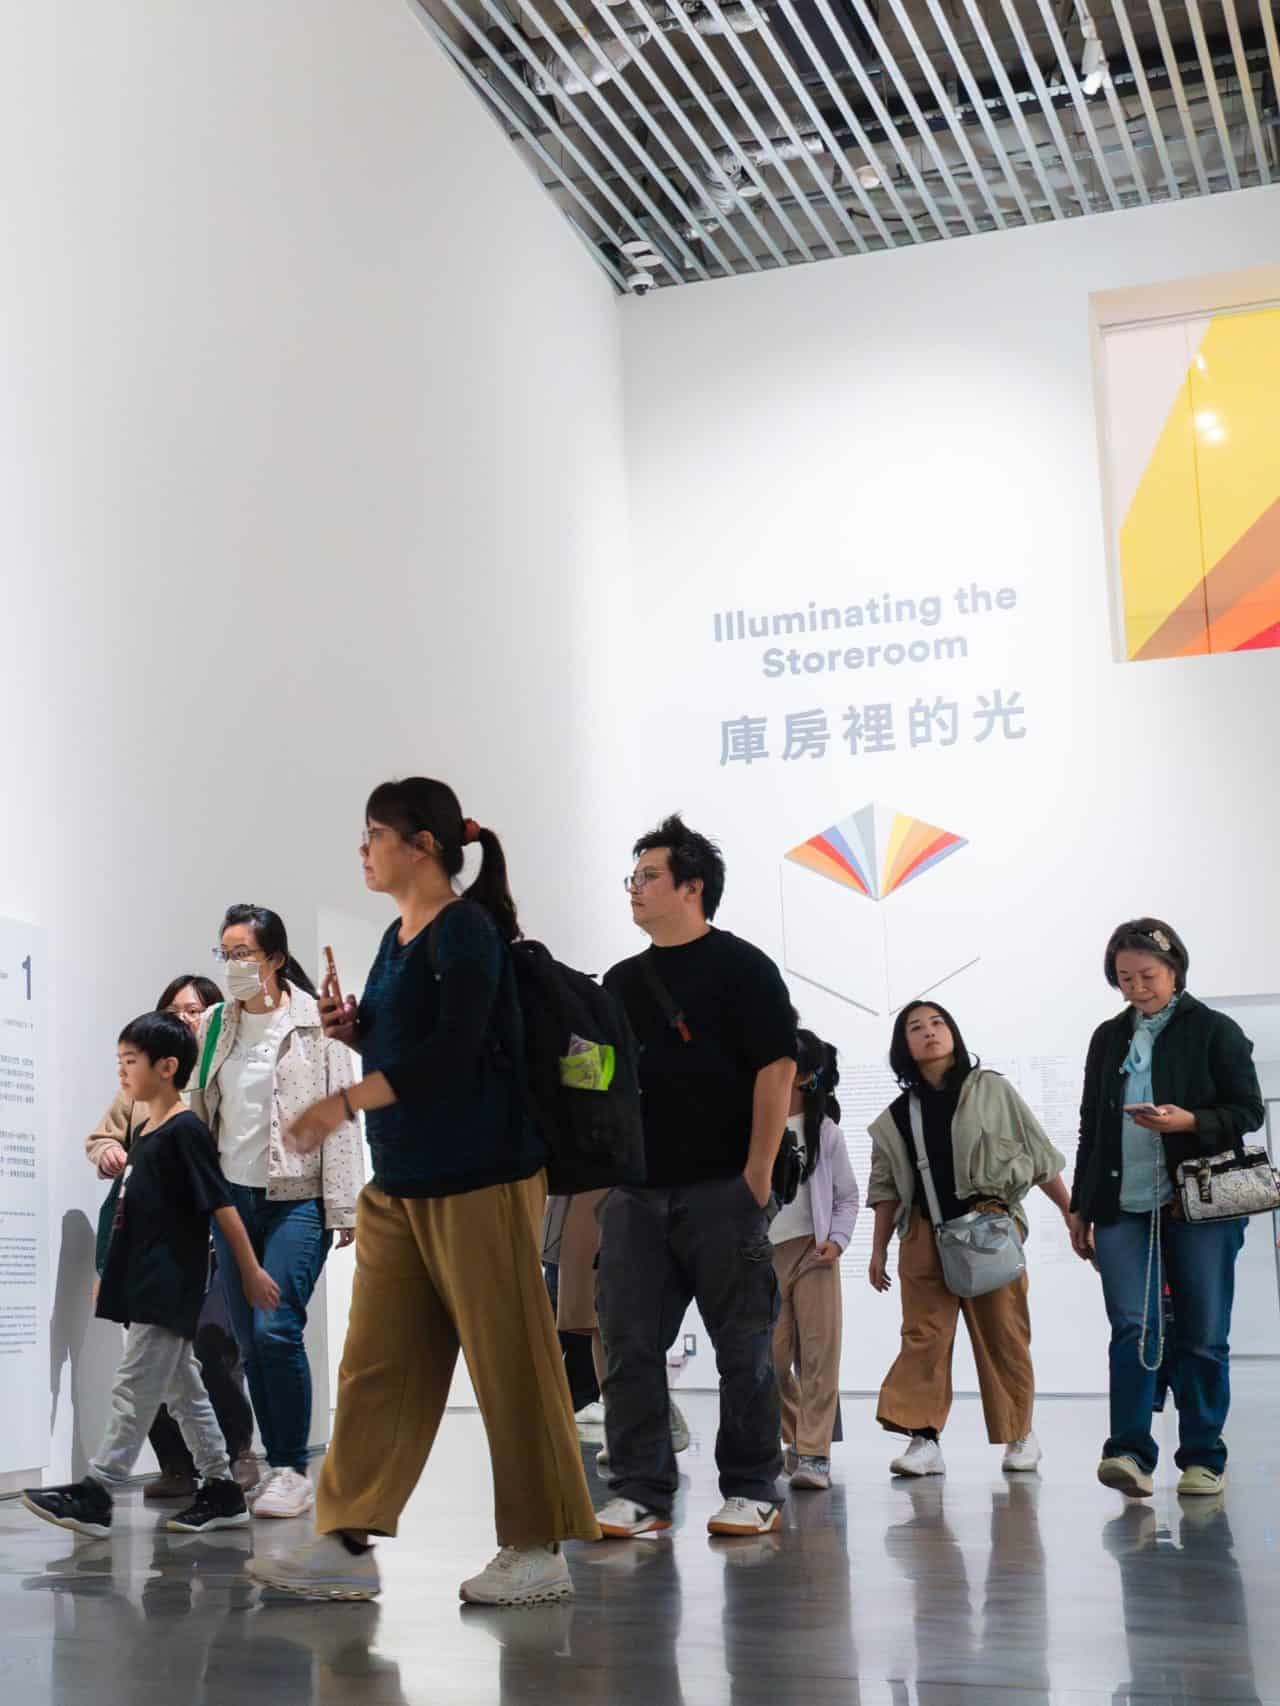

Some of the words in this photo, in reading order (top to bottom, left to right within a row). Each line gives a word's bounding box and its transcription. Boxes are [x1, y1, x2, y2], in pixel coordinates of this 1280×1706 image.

[713, 592, 942, 643] Illuminating
[954, 582, 1017, 615] the
[762, 635, 968, 678] Storeroom
[720, 688, 1027, 767] 庫房裡的光
[22, 954, 31, 1001] 1
